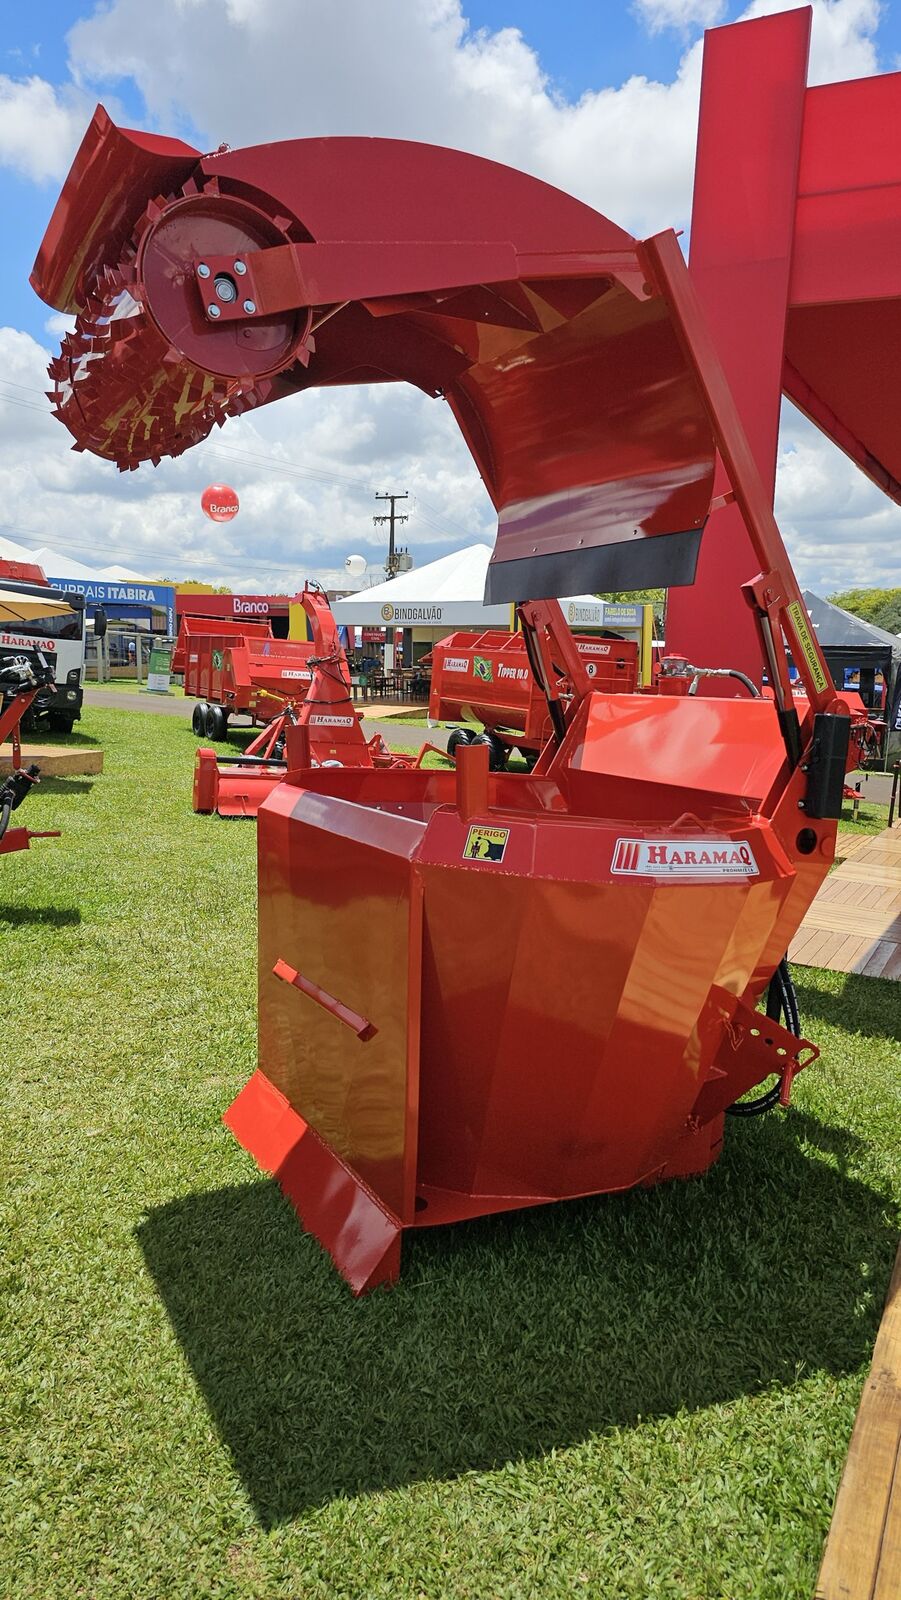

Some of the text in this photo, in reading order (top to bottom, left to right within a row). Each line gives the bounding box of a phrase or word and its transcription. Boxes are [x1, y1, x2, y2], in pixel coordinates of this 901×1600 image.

[209, 503, 238, 513] Branco
[107, 586, 156, 602] ITABIRA
[233, 597, 269, 614] Branco
[791, 605, 804, 632] TRAVA
[1, 635, 55, 651] HARAMAQ
[801, 629, 809, 644] DE
[588, 664, 594, 674] 8
[804, 641, 825, 689] SEGURANÇA
[472, 828, 506, 839] PERIGO
[647, 845, 752, 866] HARAMAQ
